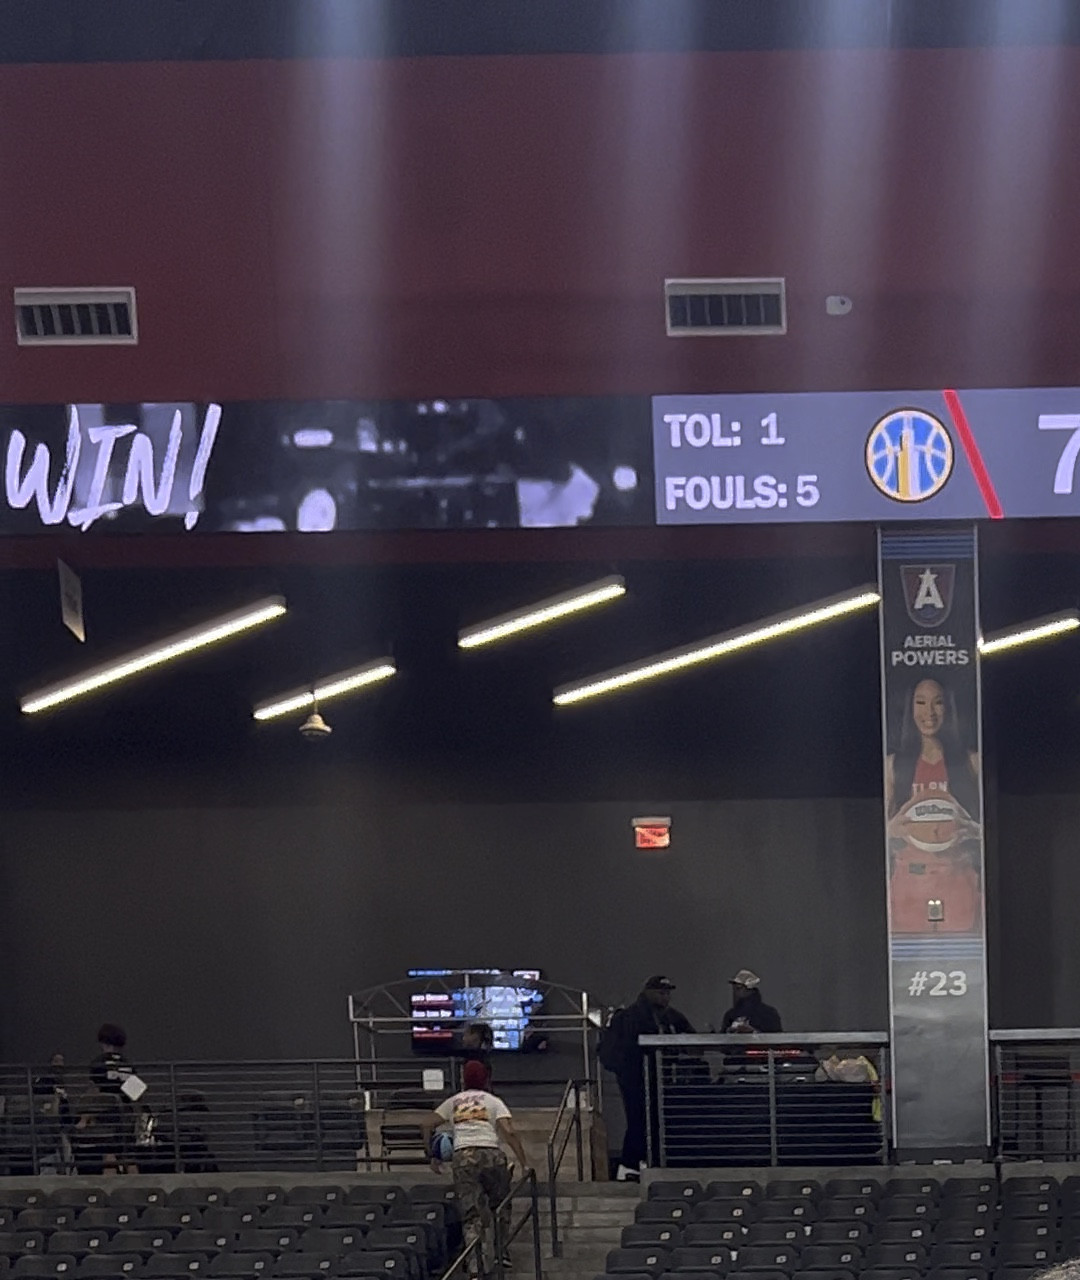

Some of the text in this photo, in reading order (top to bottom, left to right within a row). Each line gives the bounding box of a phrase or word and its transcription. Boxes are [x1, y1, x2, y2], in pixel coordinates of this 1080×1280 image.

[663, 411, 786, 448] TOL: 1
[5, 403, 222, 532] WIN!
[664, 474, 820, 511] FOULS: 5
[904, 634, 956, 649] AERIAL
[891, 649, 970, 667] POWERS
[908, 970, 968, 997] #23
